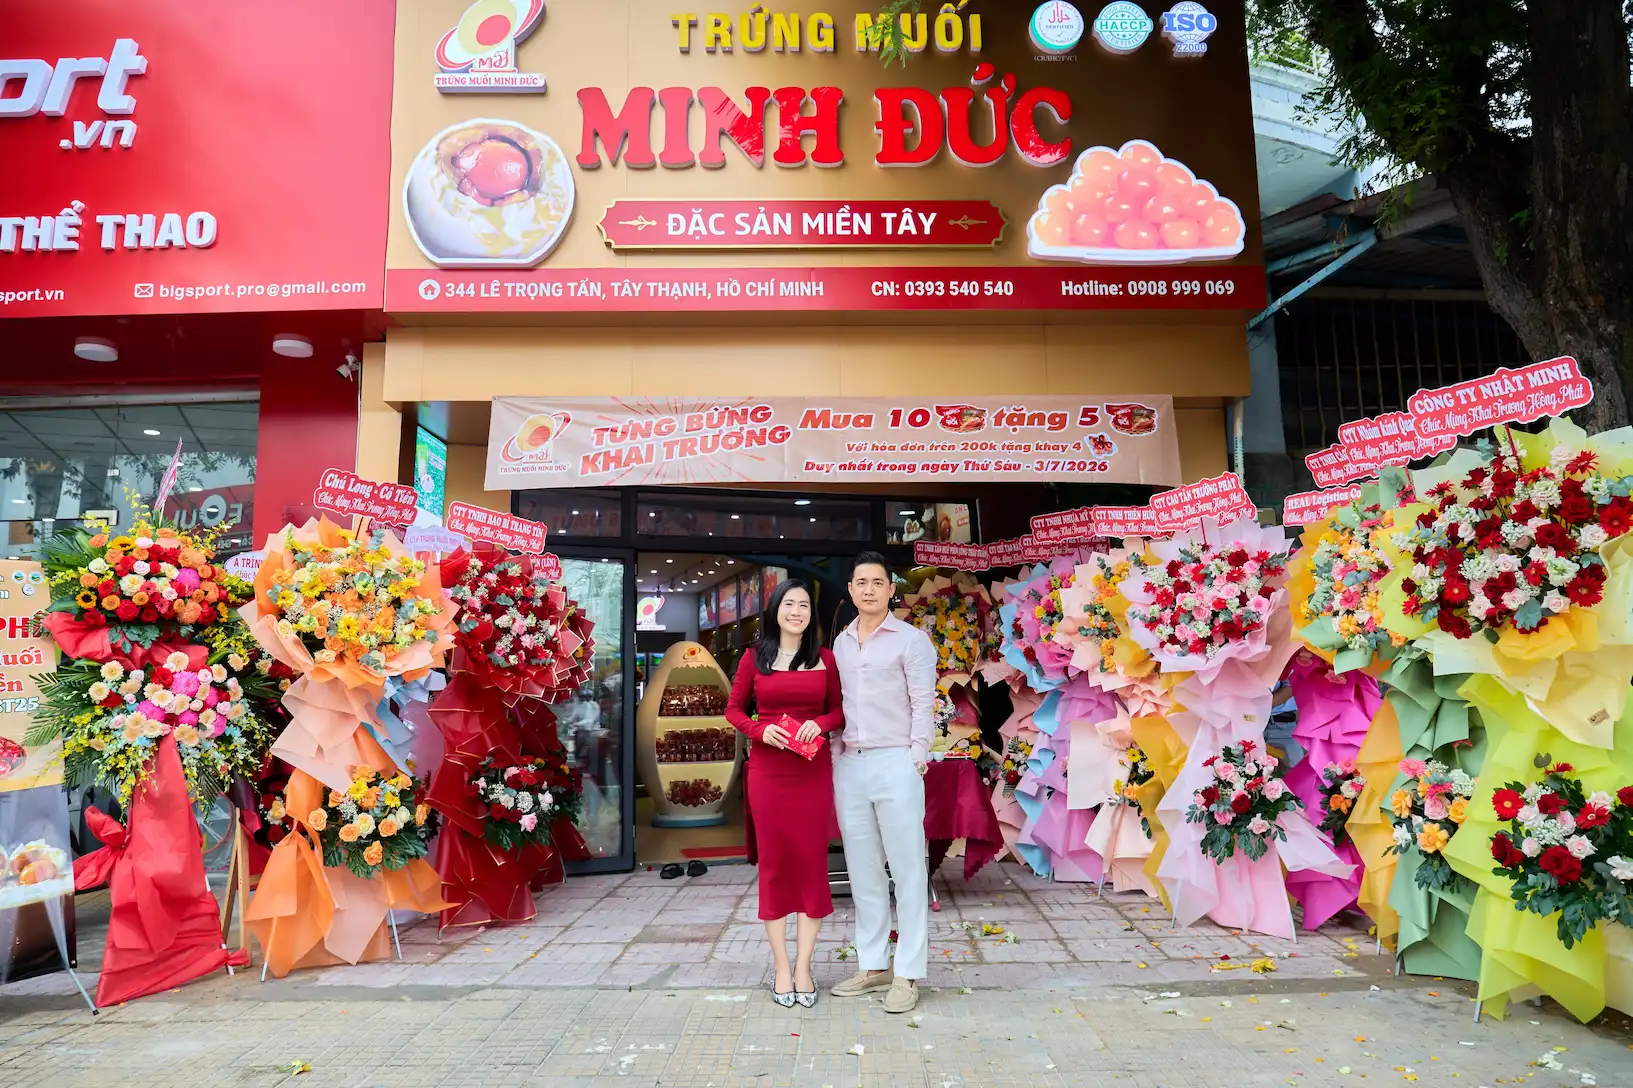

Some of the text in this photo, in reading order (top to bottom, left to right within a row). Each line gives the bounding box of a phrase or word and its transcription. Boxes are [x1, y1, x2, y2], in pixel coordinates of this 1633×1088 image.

[672, 3, 835, 53] TRỨNG
[1100, 21, 1148, 30] HACCP
[1164, 13, 1216, 32] ISO
[1176, 43, 1207, 52] 22000
[436, 74, 538, 85] TRỨNG MUỐI MINH ĐỨC
[576, 62, 1072, 169] MINH ĐỨC
[59, 119, 138, 151] .vn
[96, 211, 218, 250] THAO
[666, 205, 938, 240] ĐẶC SẢN MIỀN TÂY
[445, 276, 824, 302] 344 LÊ TRỌNG TẤN, TÂY THẠNH, HỒ CHÍ MINH
[871, 282, 1014, 296] CN: 0393 540 540
[1061, 280, 1234, 296] Hotline: 0908 999 069
[1414, 363, 1574, 414] CÔNG TY NHẬT MINH
[1468, 406, 1492, 424] Khai
[1526, 390, 1558, 414] Hồng
[1557, 384, 1584, 405] Phát
[685, 405, 772, 433] BỪNG
[798, 407, 874, 430] Mua
[888, 408, 930, 428] 10
[992, 406, 1067, 433] tặng
[1078, 408, 1099, 427] 5
[1358, 424, 1382, 440] Nhôm
[580, 444, 653, 476] KHAI
[846, 440, 870, 454] Với
[872, 440, 896, 453] hóa
[929, 440, 958, 452] trên
[959, 440, 998, 452] 200k
[1000, 440, 1032, 456] tặng
[1034, 440, 1071, 455] khay
[1073, 440, 1082, 452] 4
[536, 464, 552, 473] MINH
[804, 460, 834, 474] Duy
[838, 458, 874, 472] nhất
[876, 460, 918, 475] trong
[920, 460, 960, 474] ngày
[962, 458, 992, 472] Thứ
[994, 459, 1023, 472] Sáu
[1034, 460, 1110, 474] 3/7/2026
[324, 472, 347, 489] Chú
[347, 477, 373, 498] Long
[380, 486, 394, 500] Cô
[1154, 496, 1166, 509] CTY
[1166, 494, 1180, 506] CAO
[1218, 476, 1237, 492] PHÁT
[1288, 497, 1310, 510] REAL
[1312, 490, 1348, 506] Logistics
[452, 505, 468, 517] CTY
[468, 508, 488, 522] TNHH
[487, 514, 502, 526] BAO
[502, 516, 511, 529] BÌ
[510, 520, 532, 534] TRANG
[1096, 510, 1108, 520] CTY
